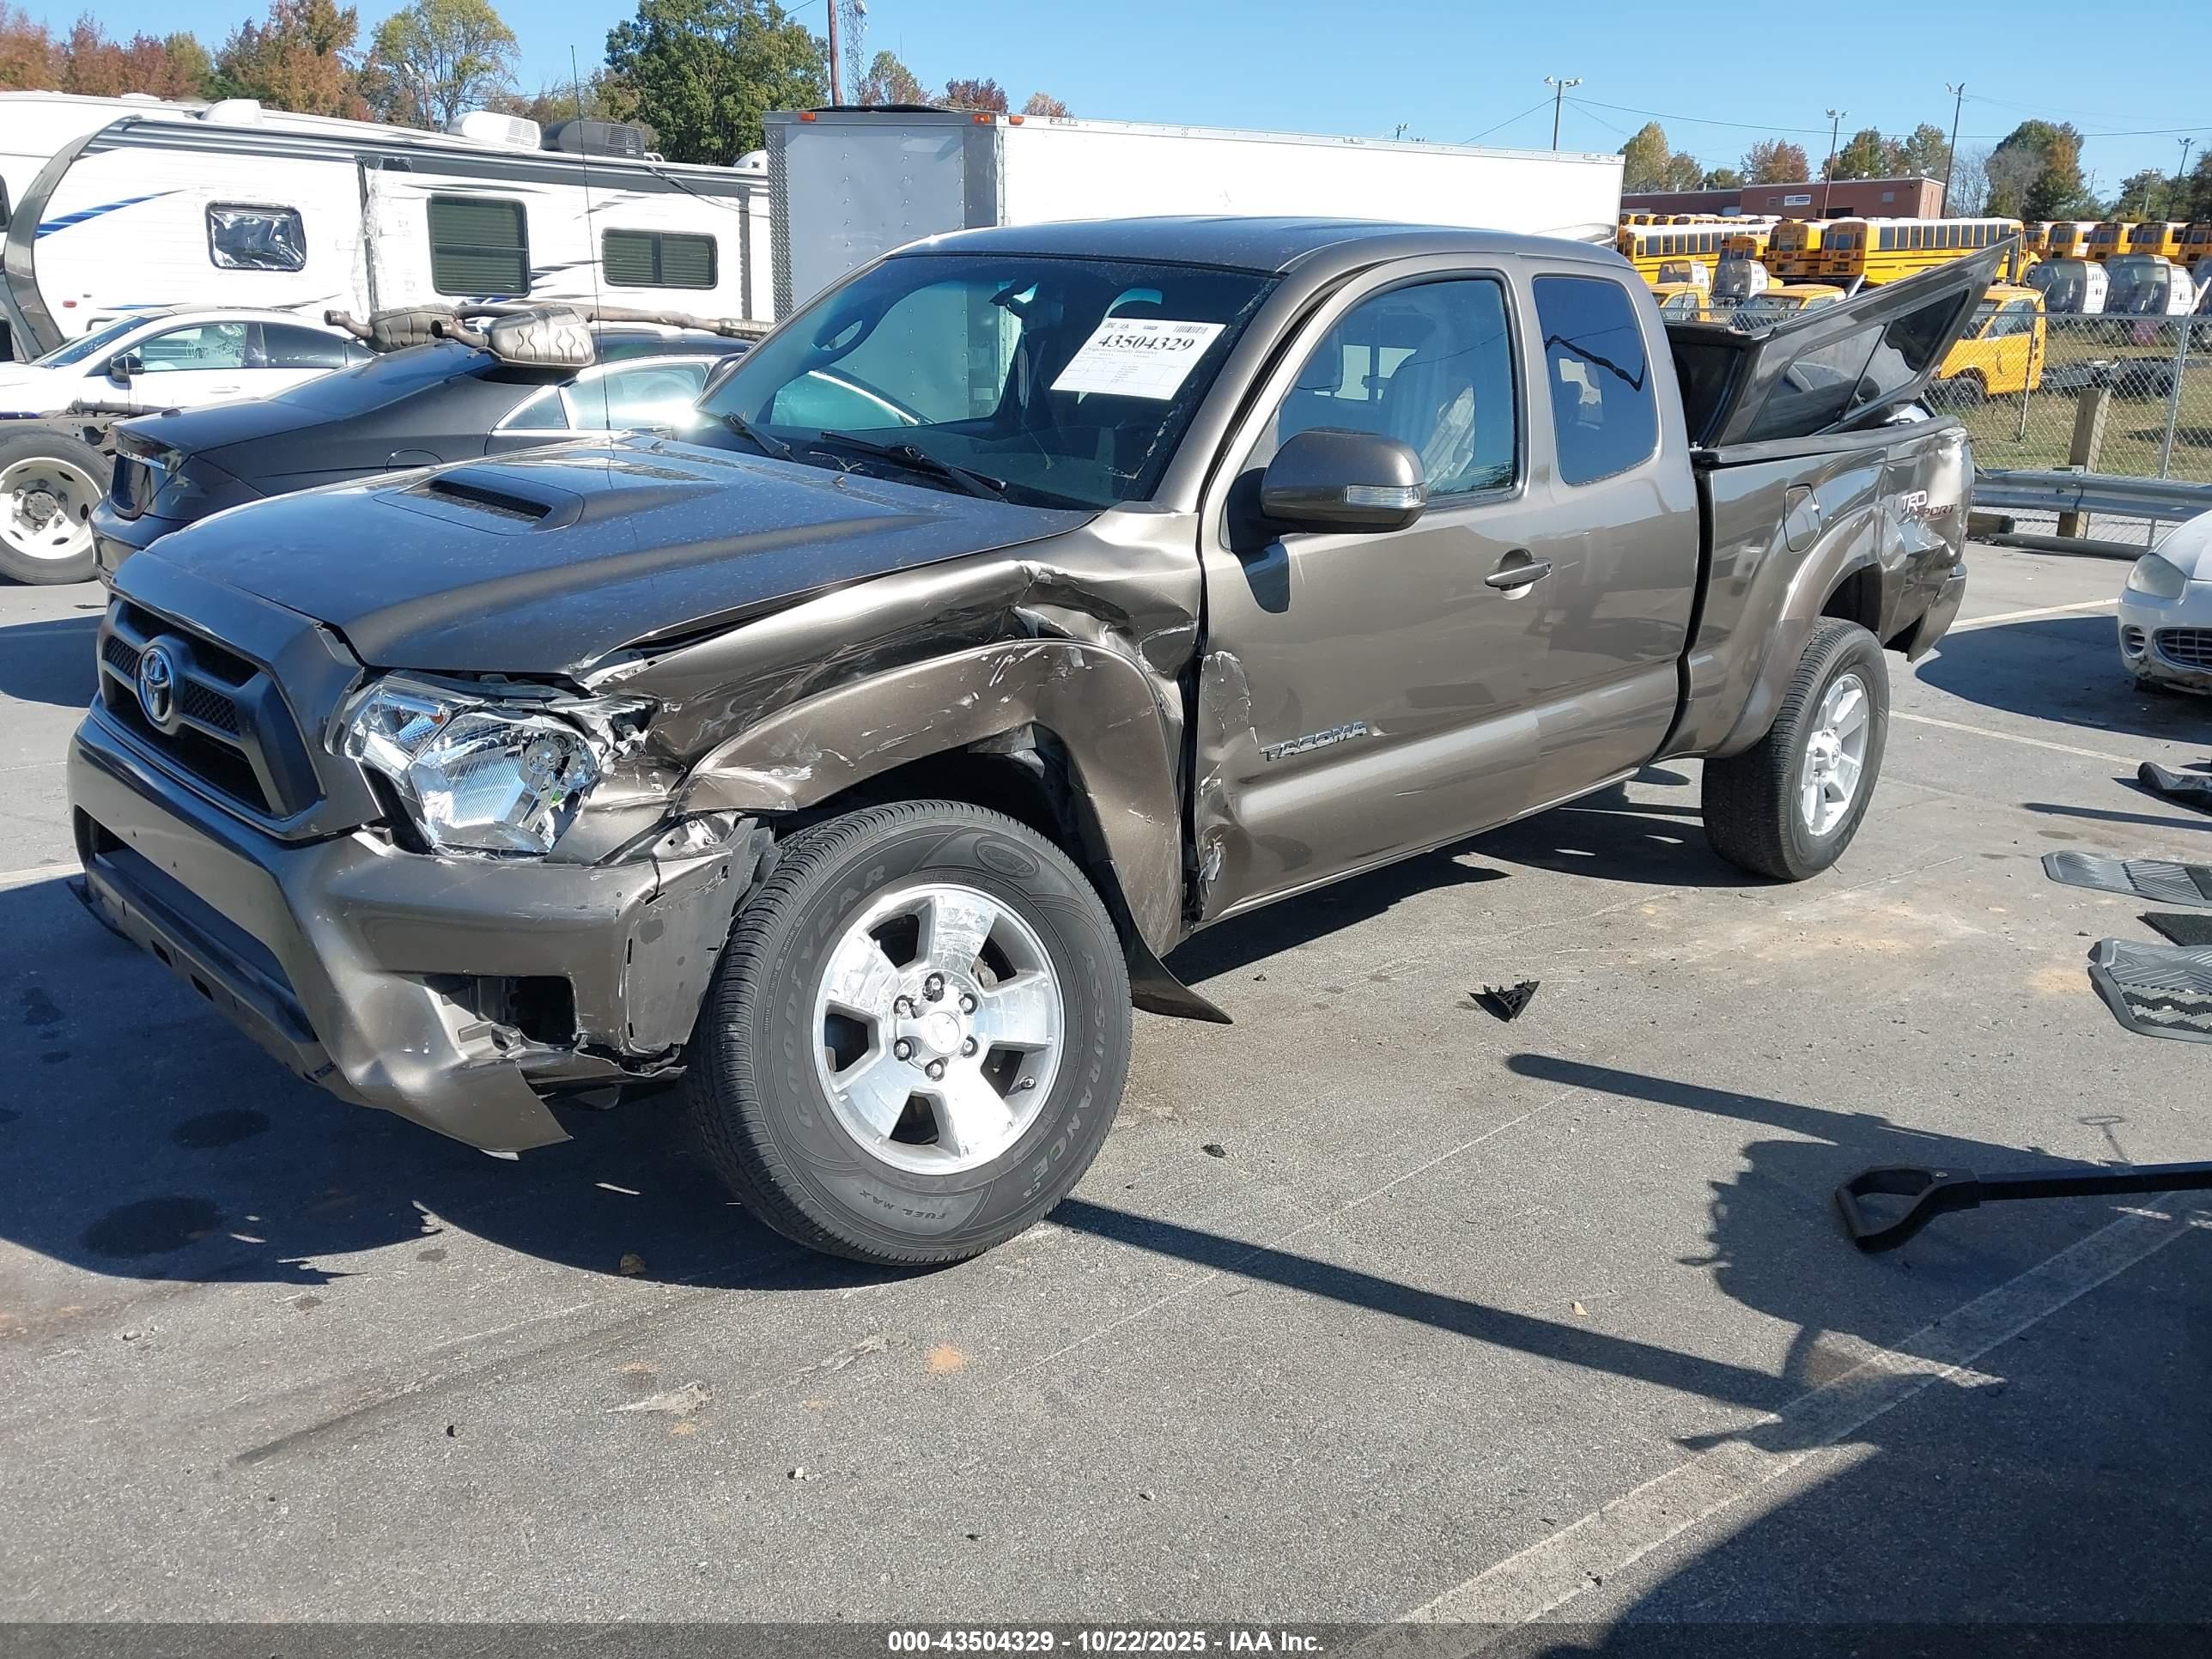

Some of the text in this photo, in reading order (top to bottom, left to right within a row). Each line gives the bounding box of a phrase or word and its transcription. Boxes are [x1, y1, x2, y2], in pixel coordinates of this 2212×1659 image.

[1097, 333, 1195, 352] 43504329
[1901, 489, 1928, 514] TRD
[1259, 721, 1368, 762] TACOMA
[902, 1207, 947, 1219] FUEL
